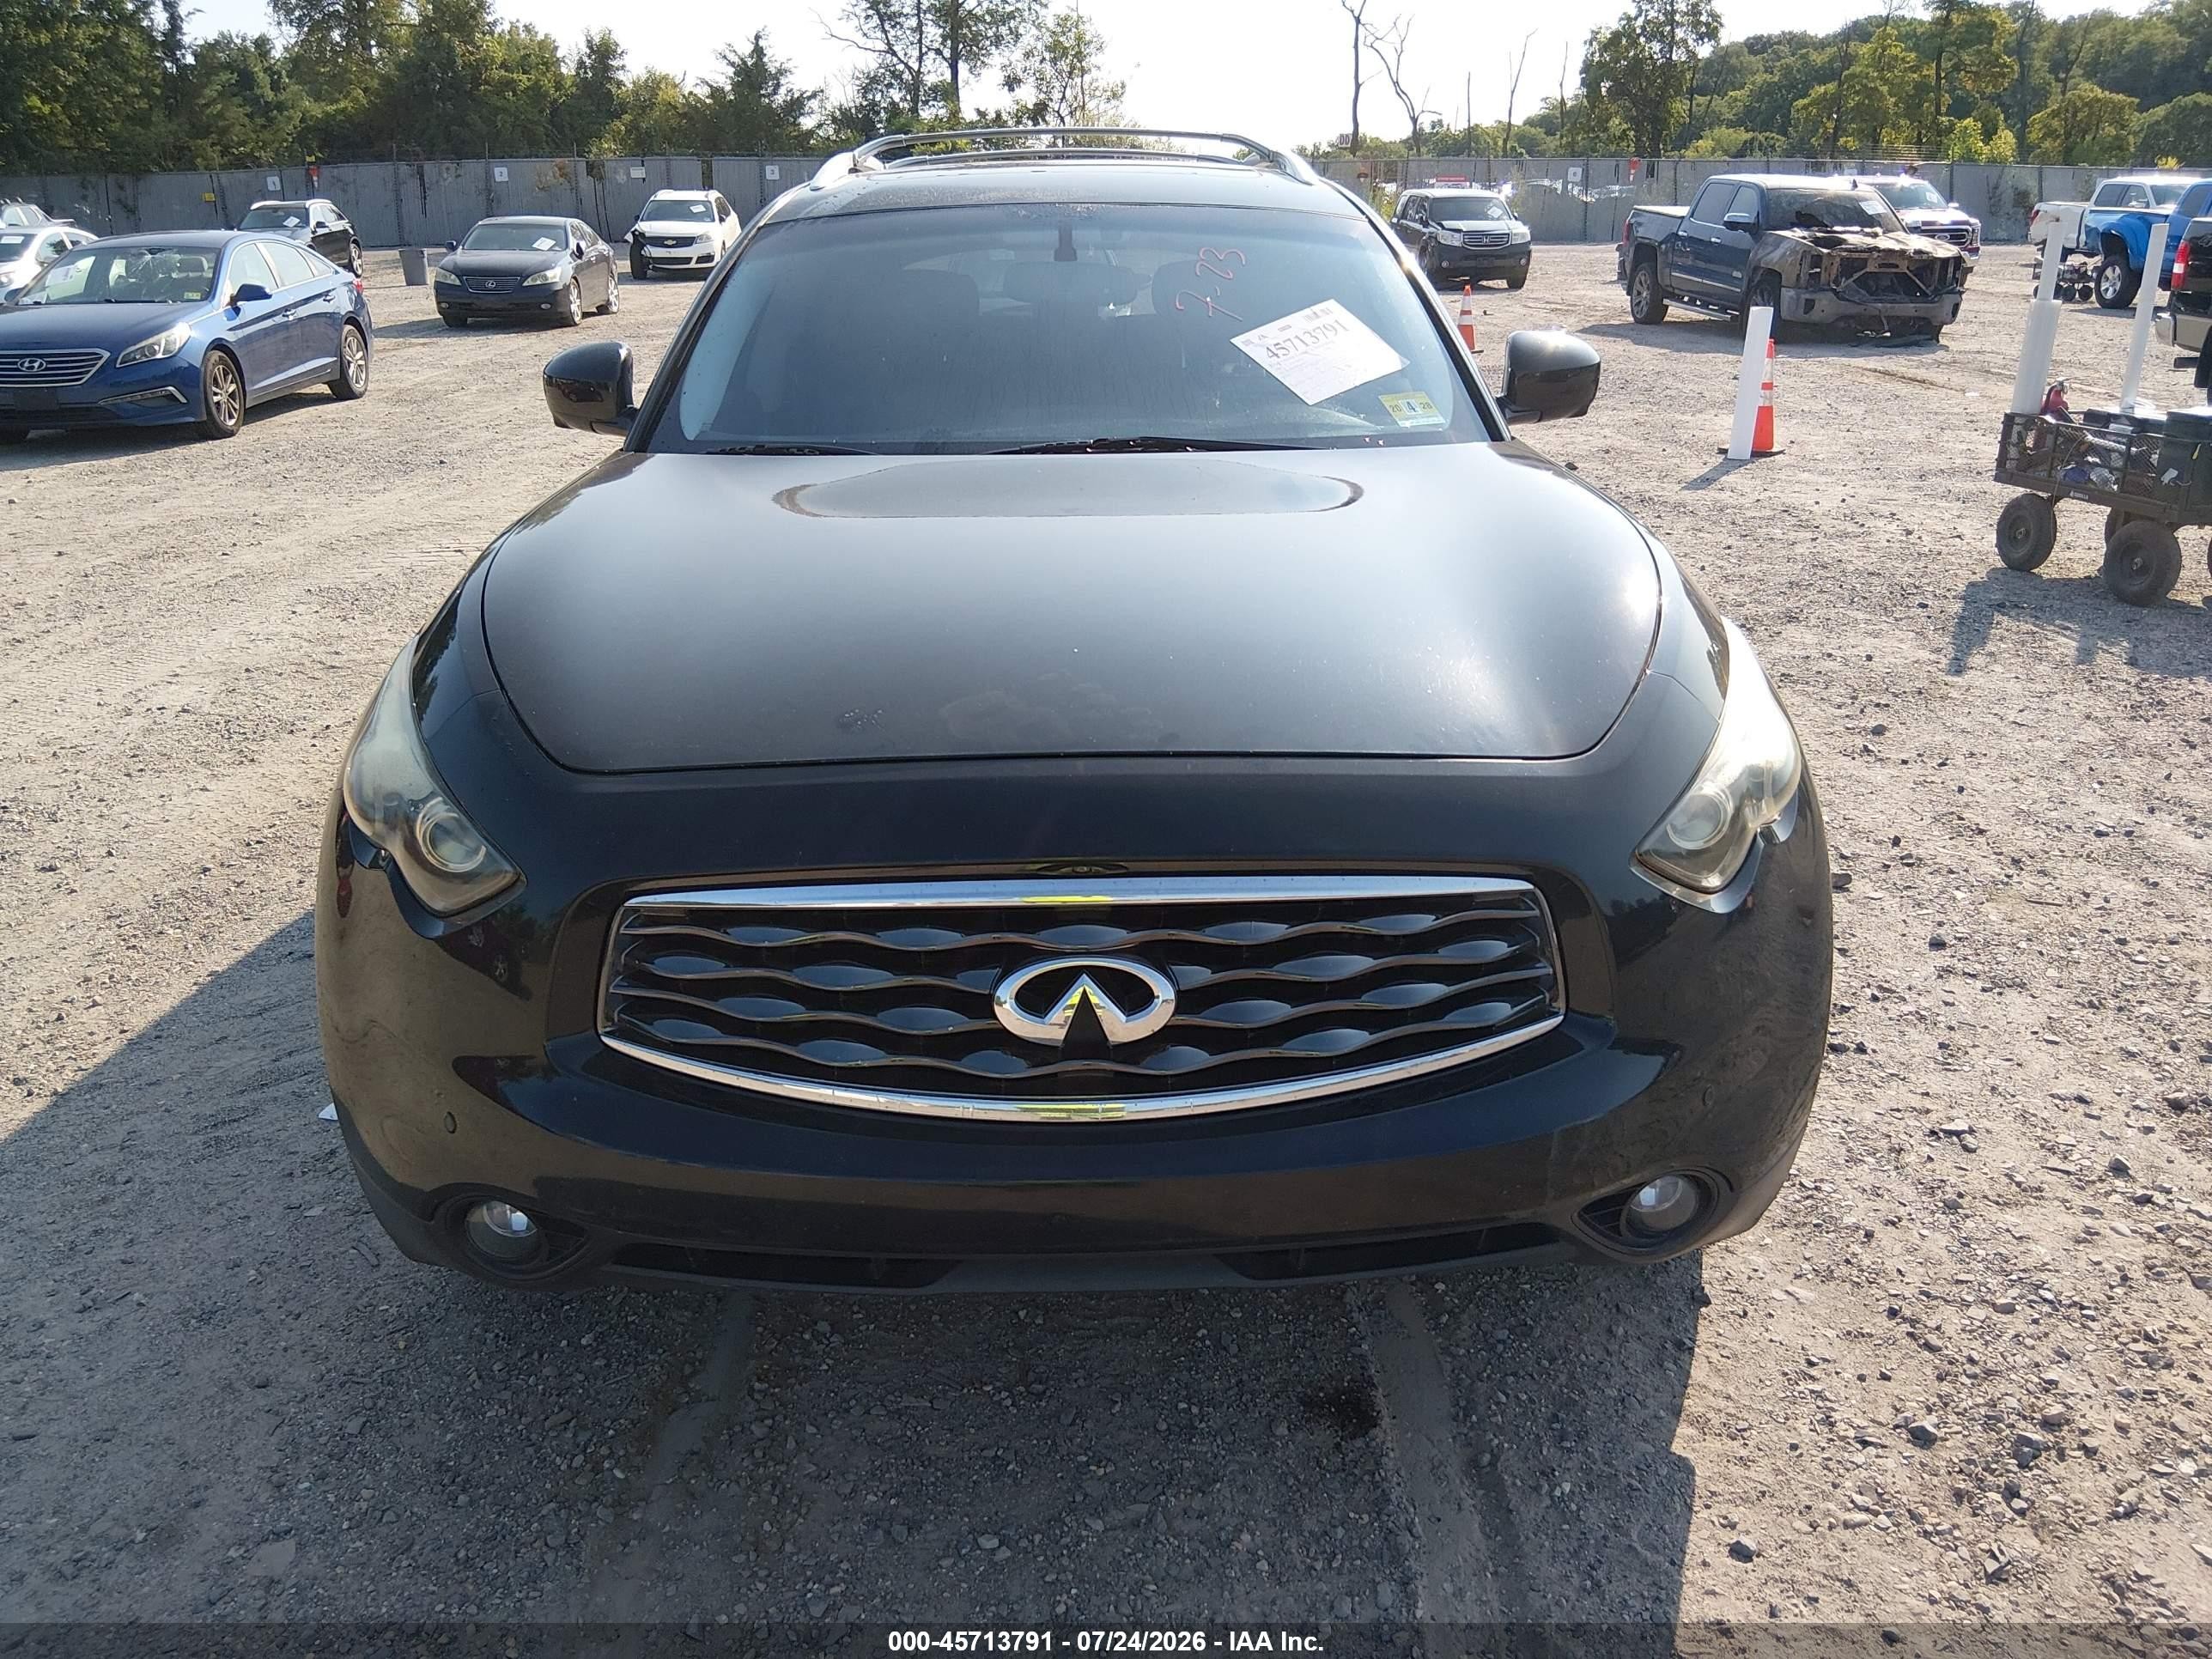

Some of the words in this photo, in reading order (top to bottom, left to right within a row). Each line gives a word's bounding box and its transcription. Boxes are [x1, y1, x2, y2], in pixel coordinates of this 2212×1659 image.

[1176, 247, 1246, 322] 7-23
[1266, 319, 1350, 359] 45713791
[1389, 404, 1402, 413] 20
[1406, 401, 1418, 413] 4
